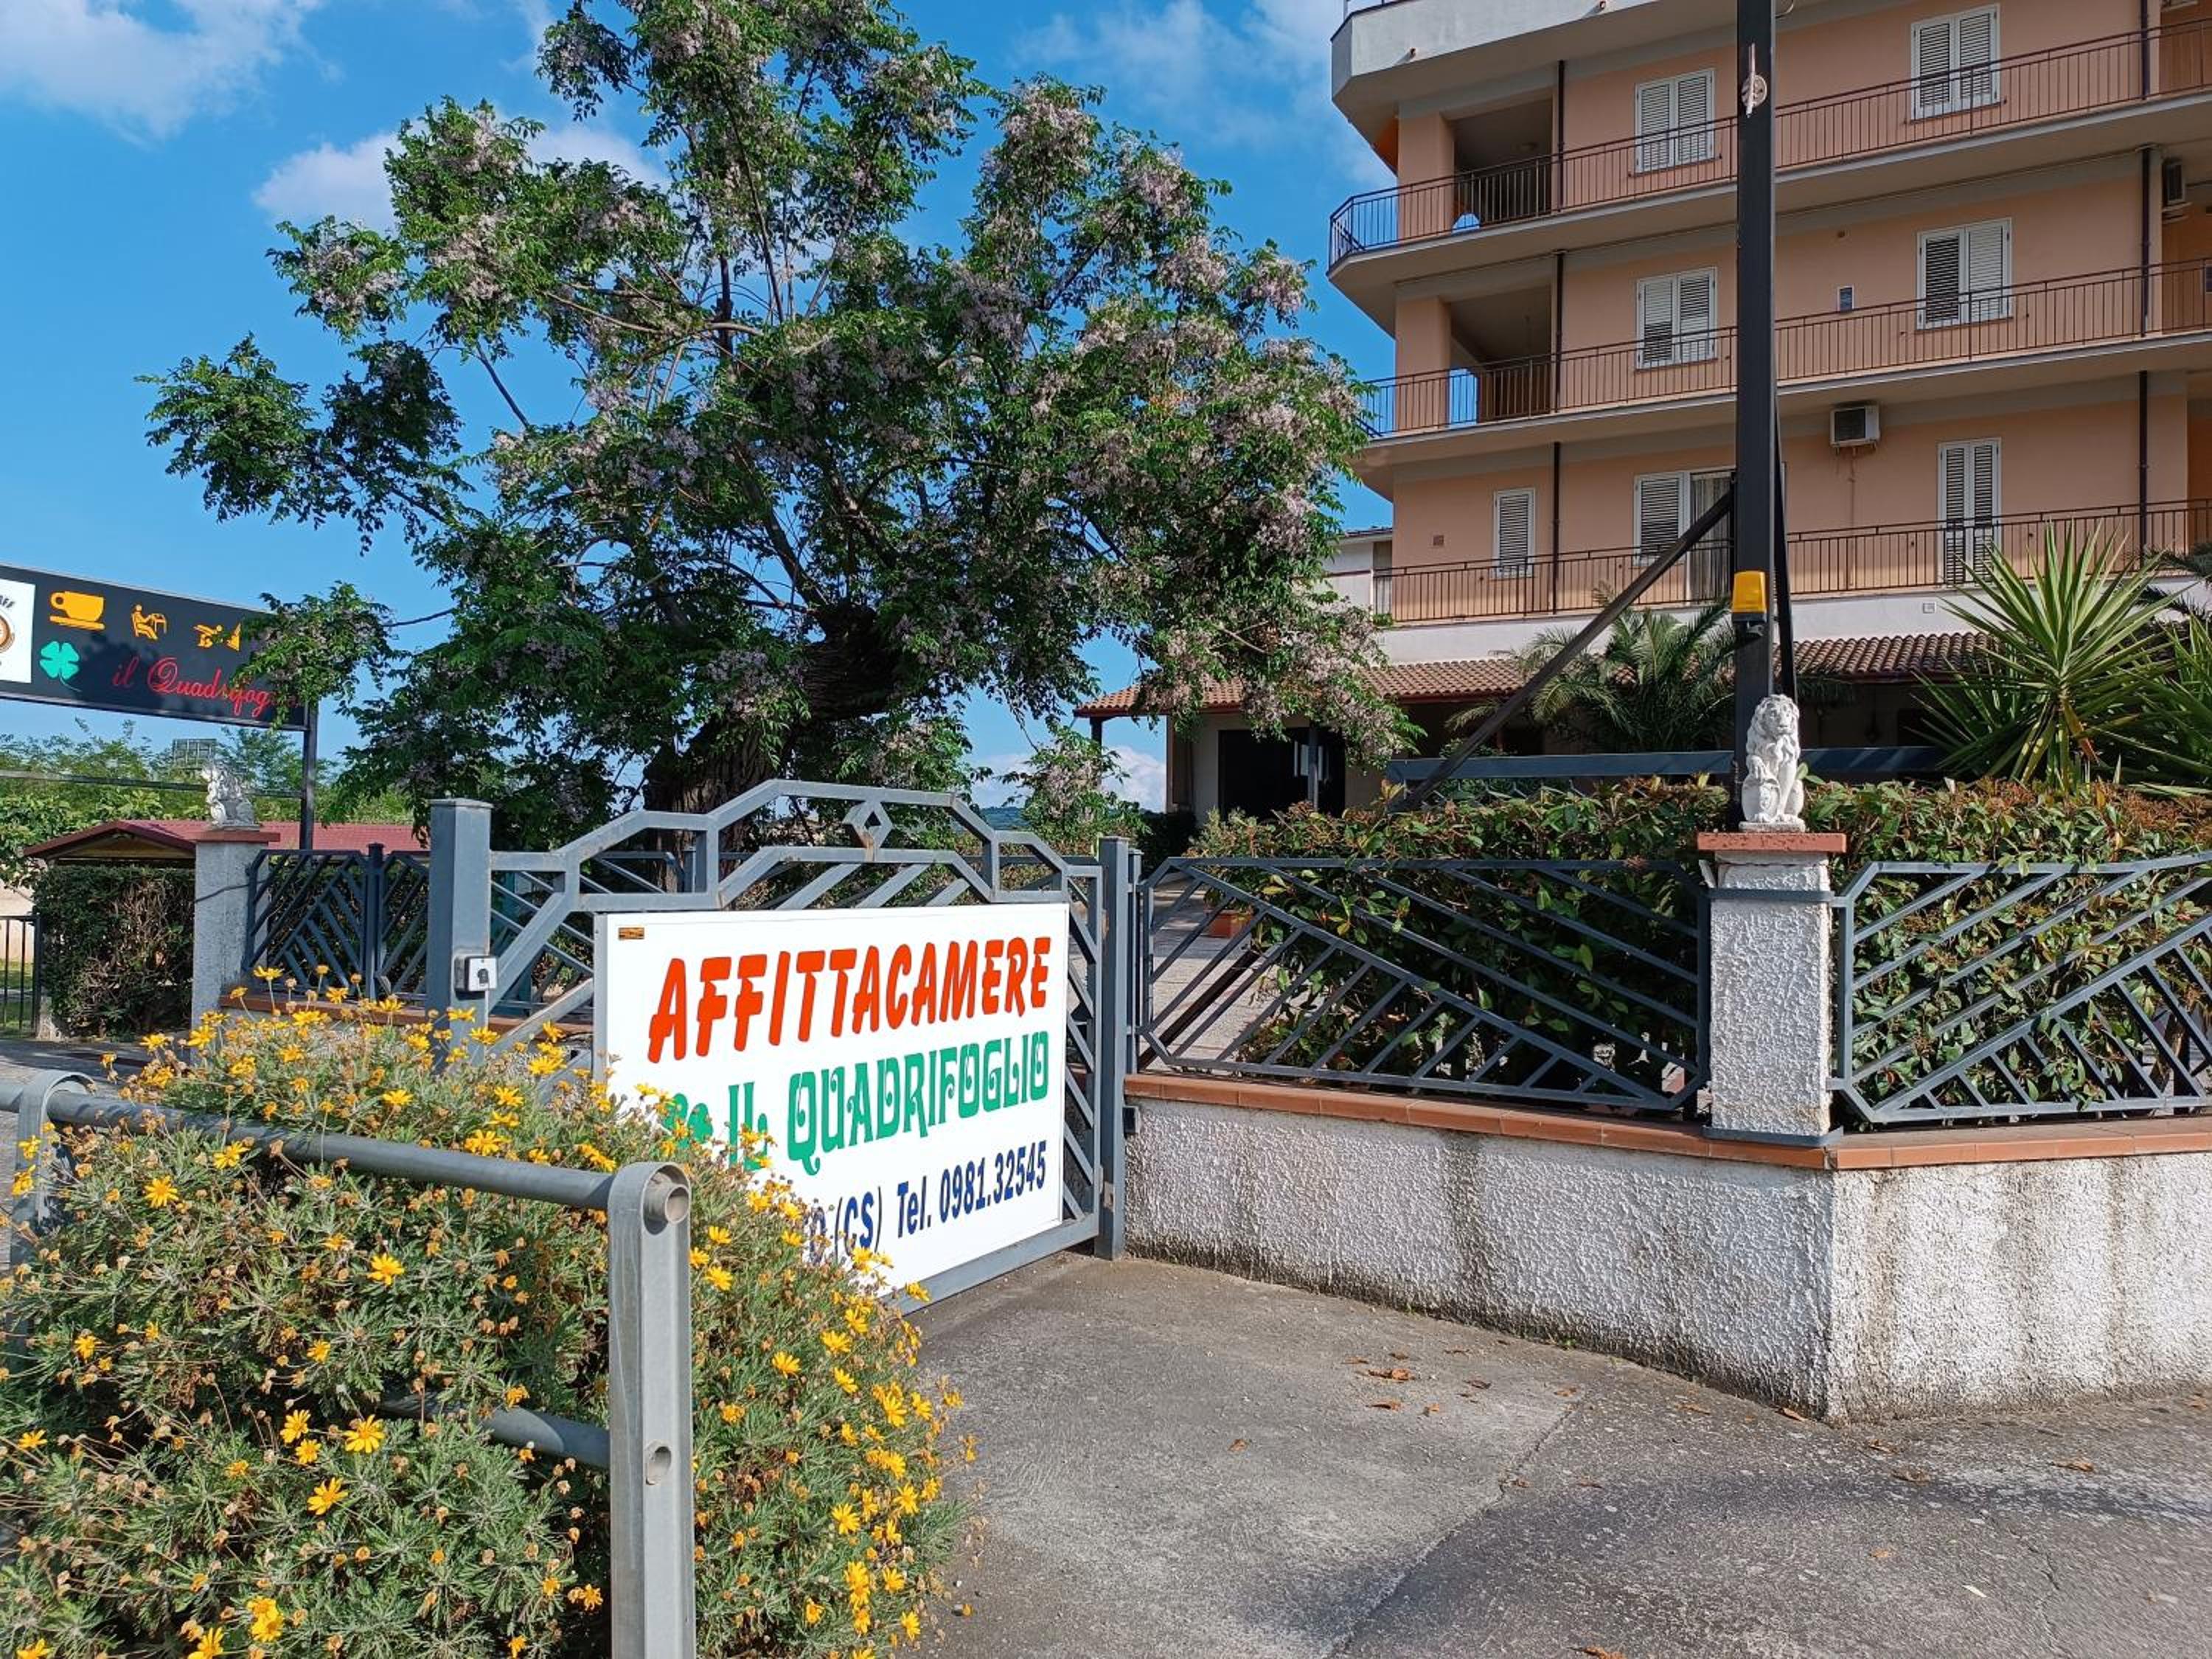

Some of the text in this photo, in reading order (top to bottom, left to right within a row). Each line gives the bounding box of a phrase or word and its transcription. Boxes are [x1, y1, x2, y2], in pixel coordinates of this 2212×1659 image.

[647, 937, 1051, 1063] AFFITTACAMERE
[787, 1031, 1048, 1175] QUADRIFOGLIO
[897, 1176, 931, 1237] Tel.
[939, 1140, 1047, 1223] 0981.32545
